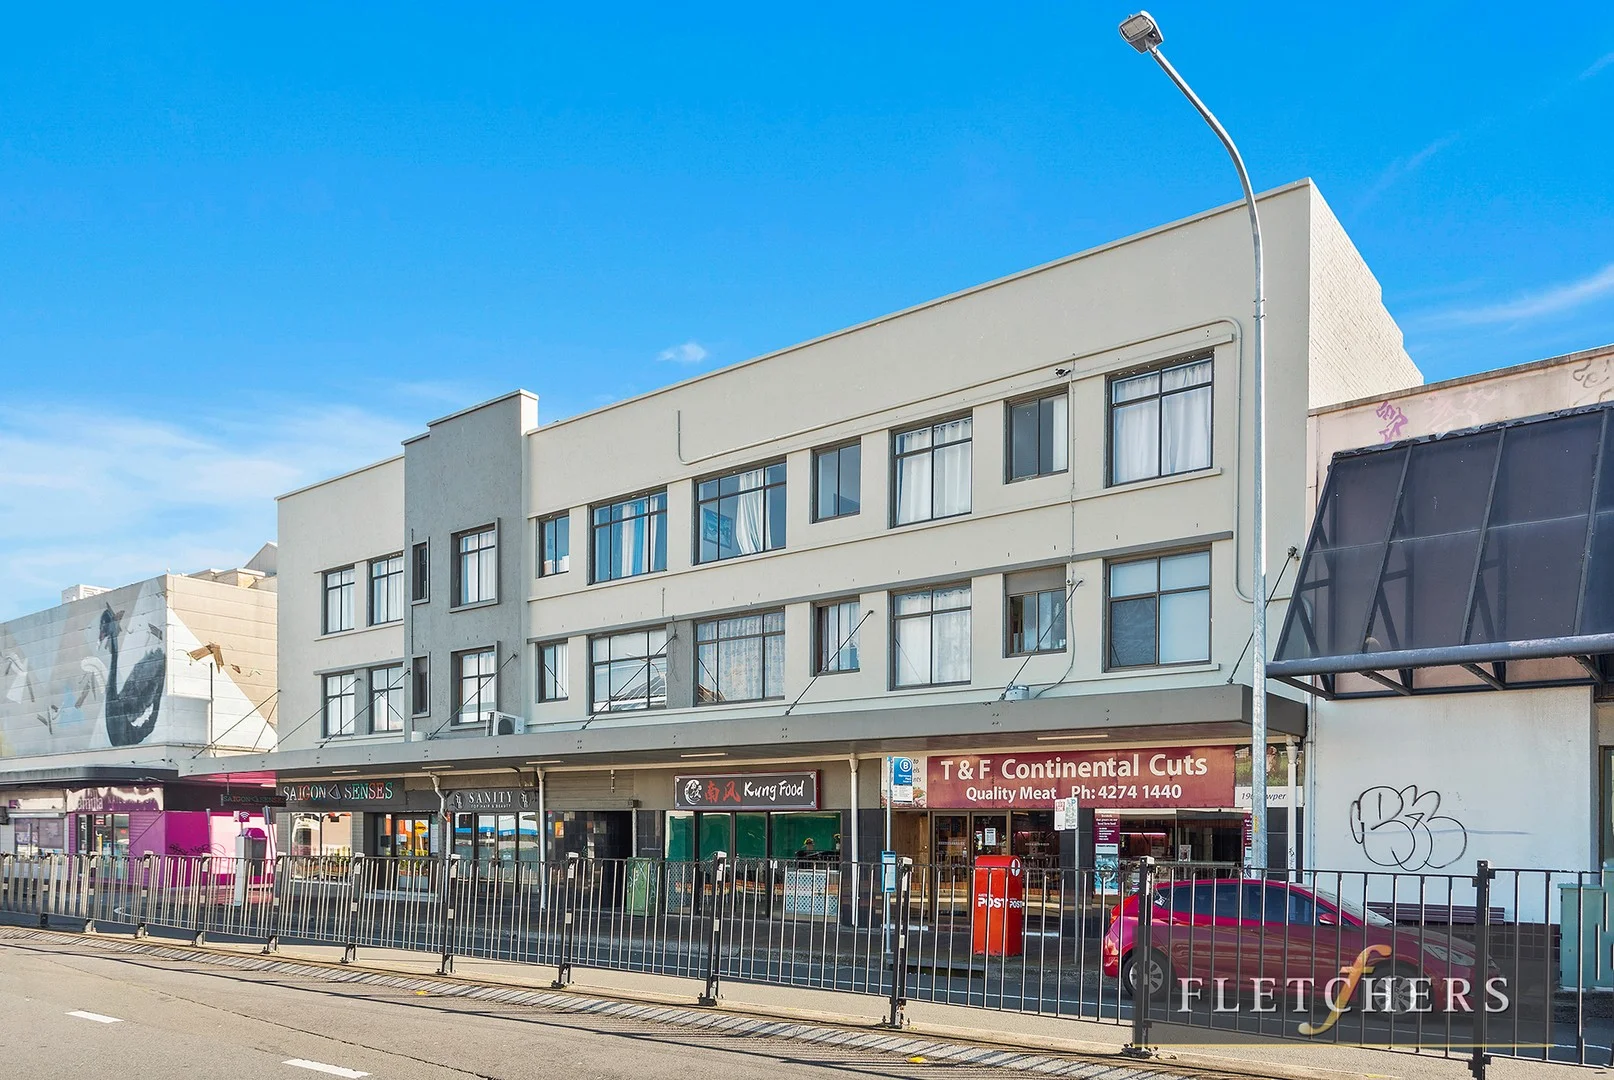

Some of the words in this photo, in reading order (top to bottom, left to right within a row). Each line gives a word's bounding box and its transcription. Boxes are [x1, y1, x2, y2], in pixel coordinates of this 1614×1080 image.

[941, 760, 953, 780] T
[957, 759, 974, 780] &
[979, 759, 991, 780] F
[1001, 753, 1139, 779] Continental
[1149, 753, 1208, 776] Cuts
[283, 784, 327, 801] SAIGON
[344, 782, 393, 800] SENSES
[468, 790, 514, 804] SANITY
[743, 781, 777, 801] Kung
[778, 779, 805, 797] Food
[966, 786, 1016, 803] Quality
[1020, 786, 1057, 800] Meat
[1071, 785, 1096, 799] Ph:
[1097, 785, 1138, 799] 4274
[1142, 784, 1182, 799] 1440
[977, 897, 1009, 909] POST
